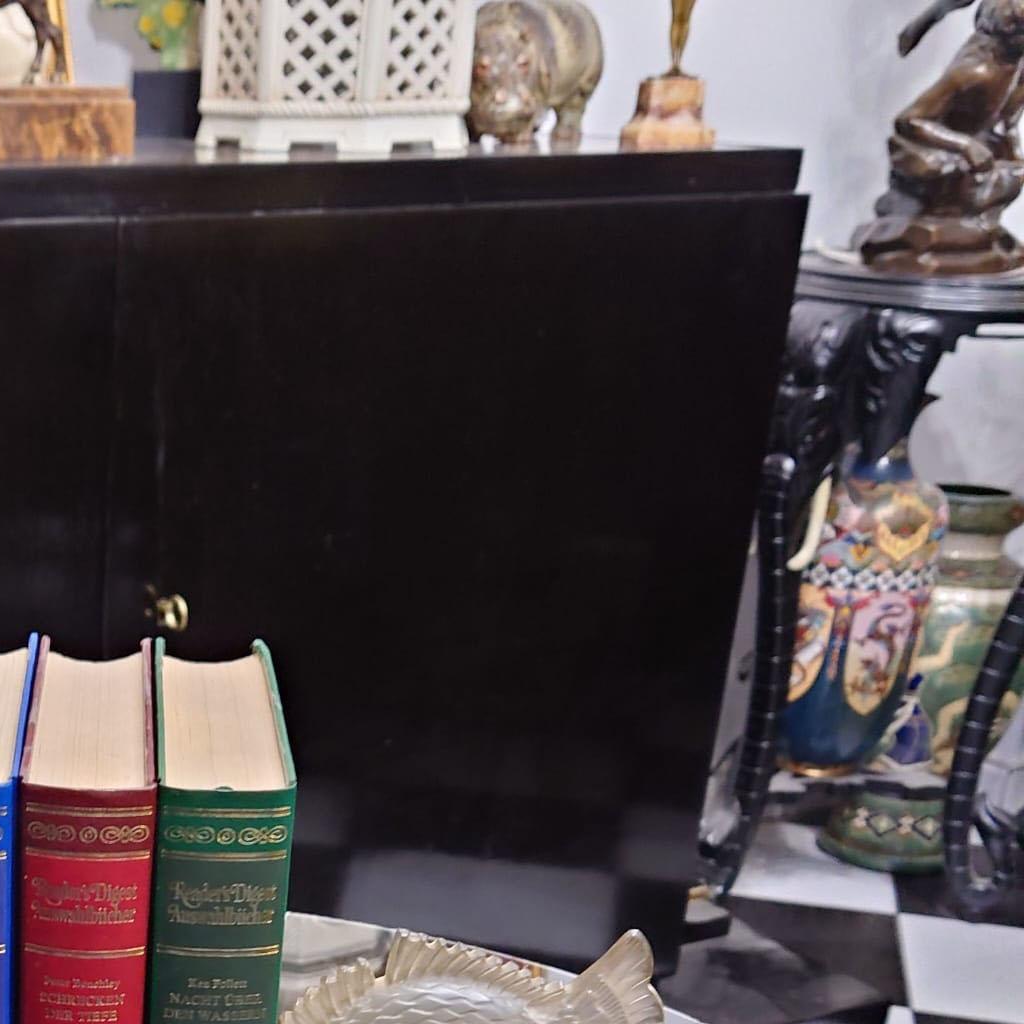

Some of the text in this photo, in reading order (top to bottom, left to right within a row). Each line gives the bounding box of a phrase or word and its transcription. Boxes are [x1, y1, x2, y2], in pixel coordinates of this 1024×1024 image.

[39, 991, 125, 1007] SCHRECKEN
[168, 992, 221, 1006] NACHT
[44, 1006, 119, 1022] DER TIEFE
